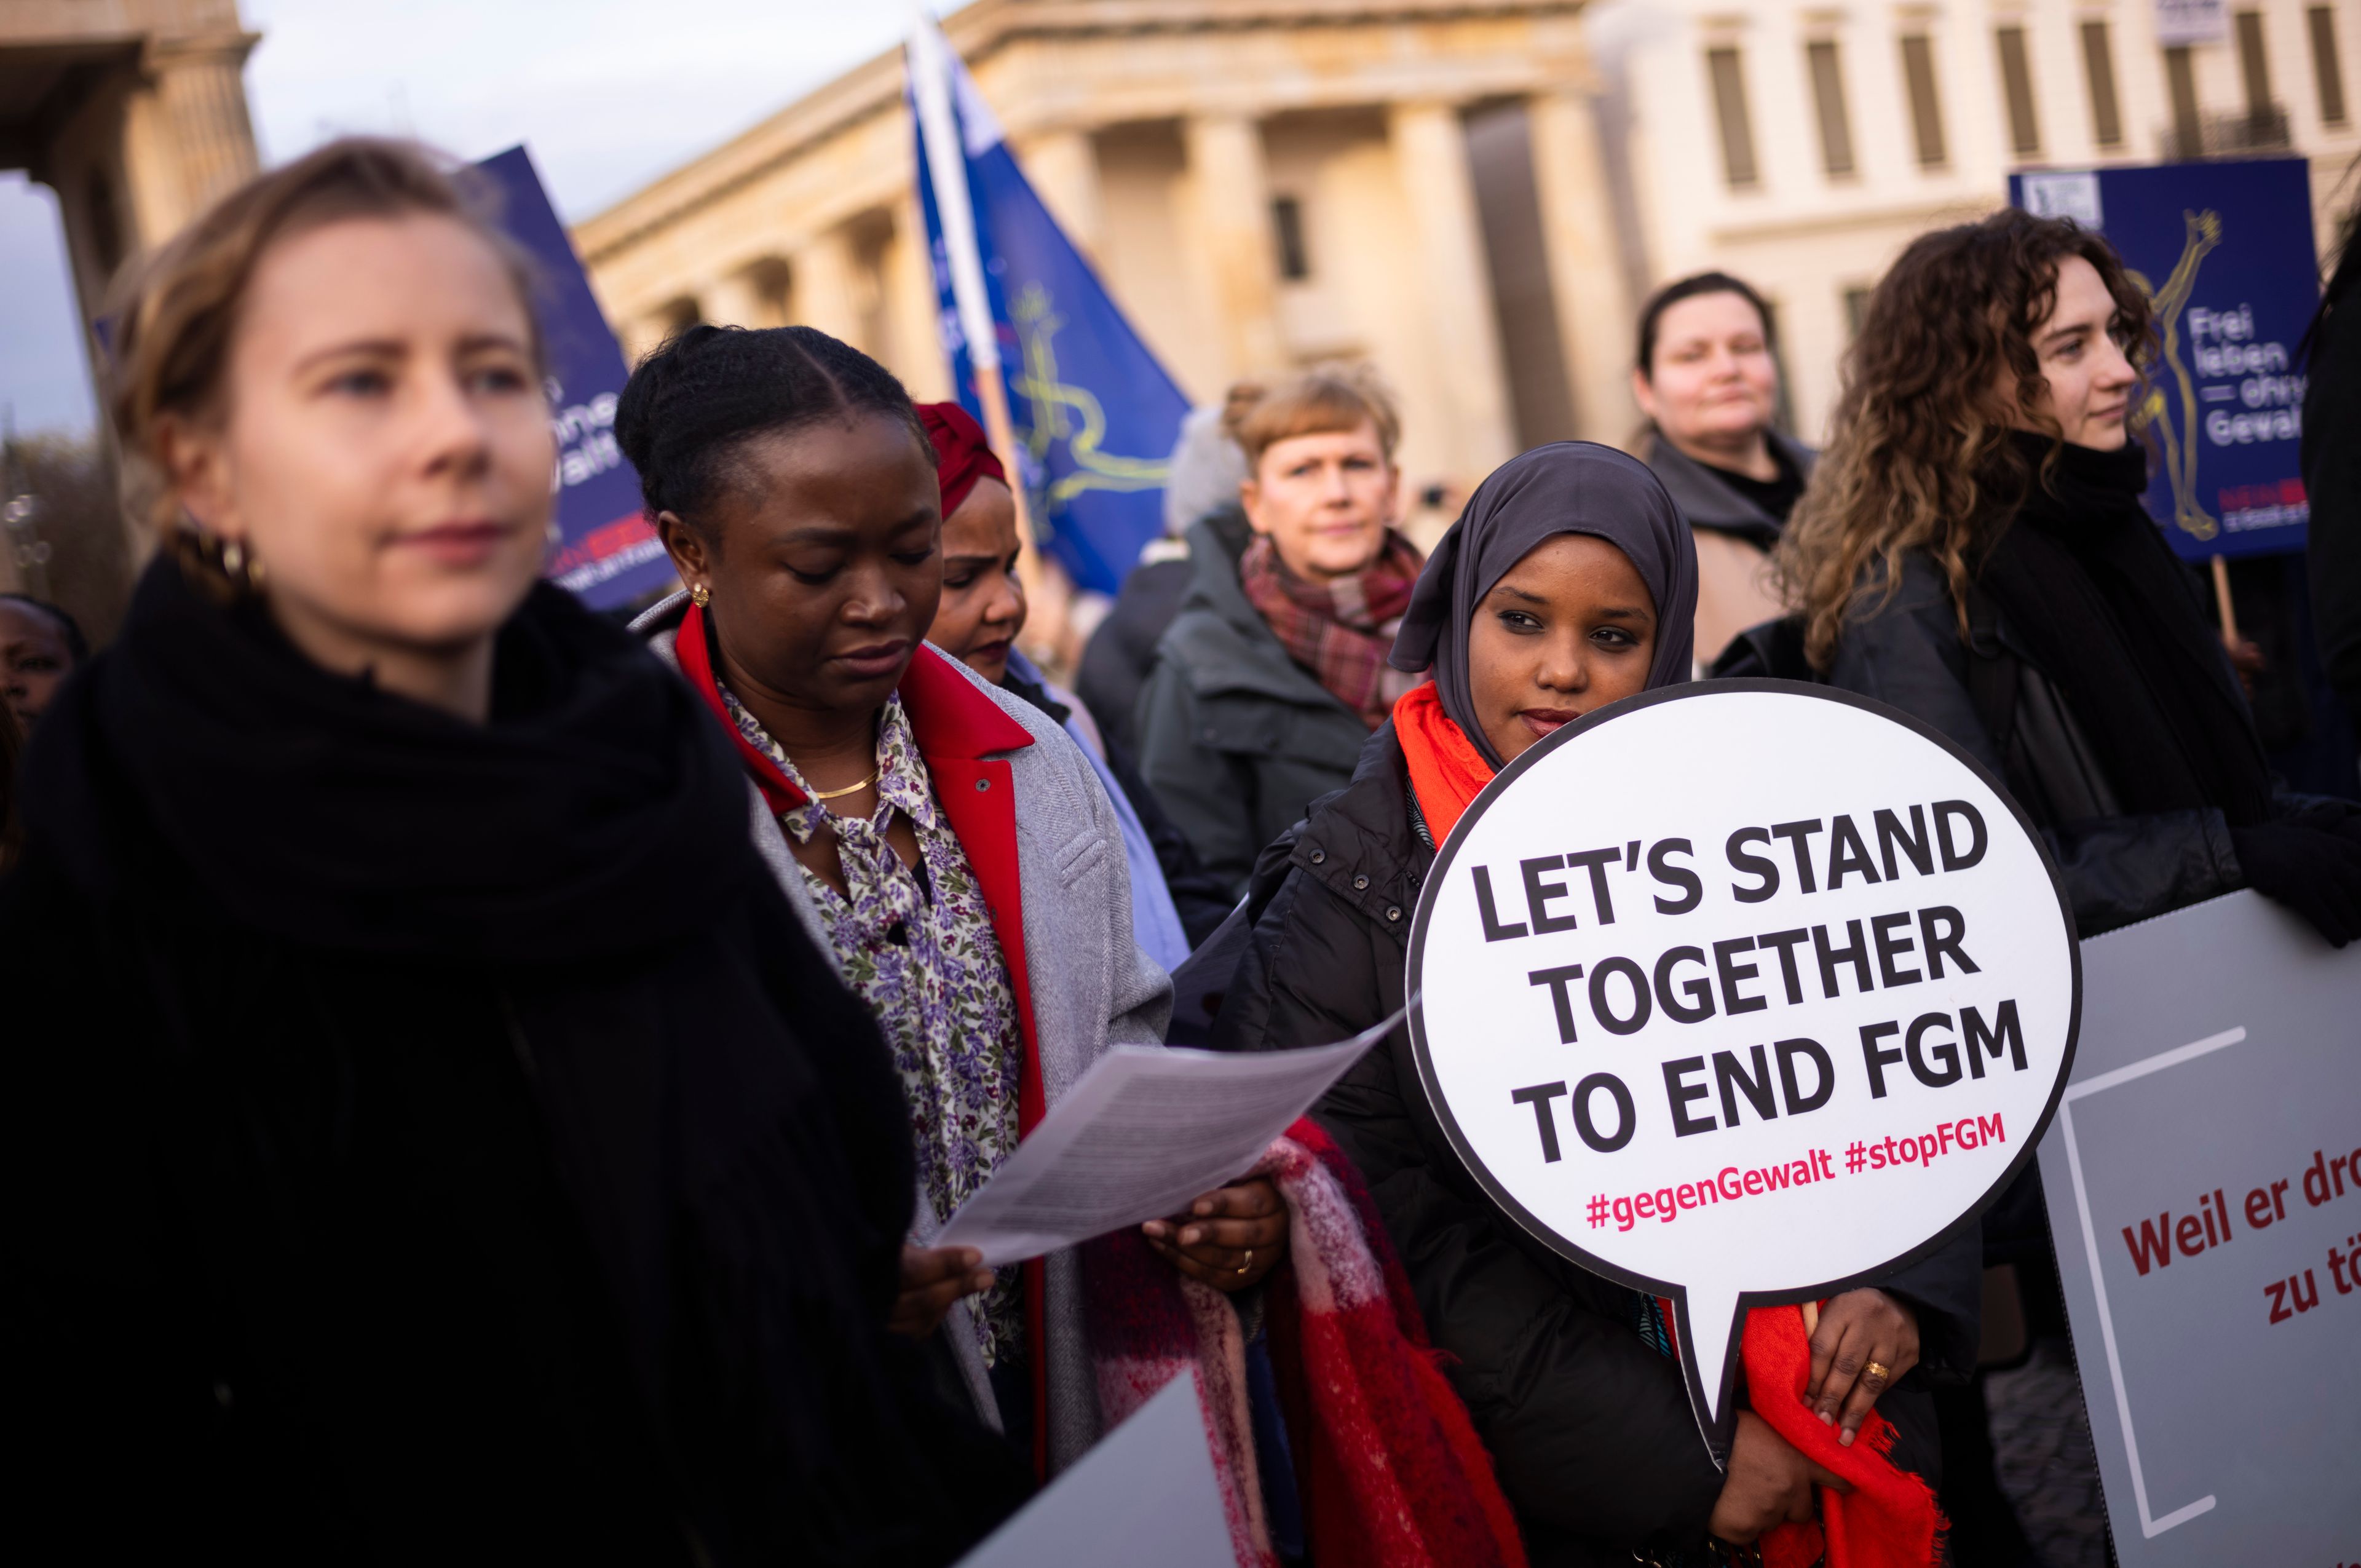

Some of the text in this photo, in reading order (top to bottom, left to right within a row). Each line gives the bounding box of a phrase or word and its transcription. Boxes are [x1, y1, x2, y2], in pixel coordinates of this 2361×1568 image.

[2189, 303, 2255, 342] Frei
[2193, 338, 2288, 379] leben
[2205, 403, 2303, 446] Gewal
[2240, 373, 2309, 409] ohn
[1471, 799, 1988, 943] LET’S STAND
[1527, 905, 1982, 1045] TOGETHER
[1511, 998, 2029, 1164] TO END FGM
[1585, 1111, 2007, 1233] #gegenGewalt #stopFGM
[2121, 1189, 2232, 1277] Weil
[2244, 1178, 2289, 1230] er
[2263, 1268, 2320, 1325] zu
